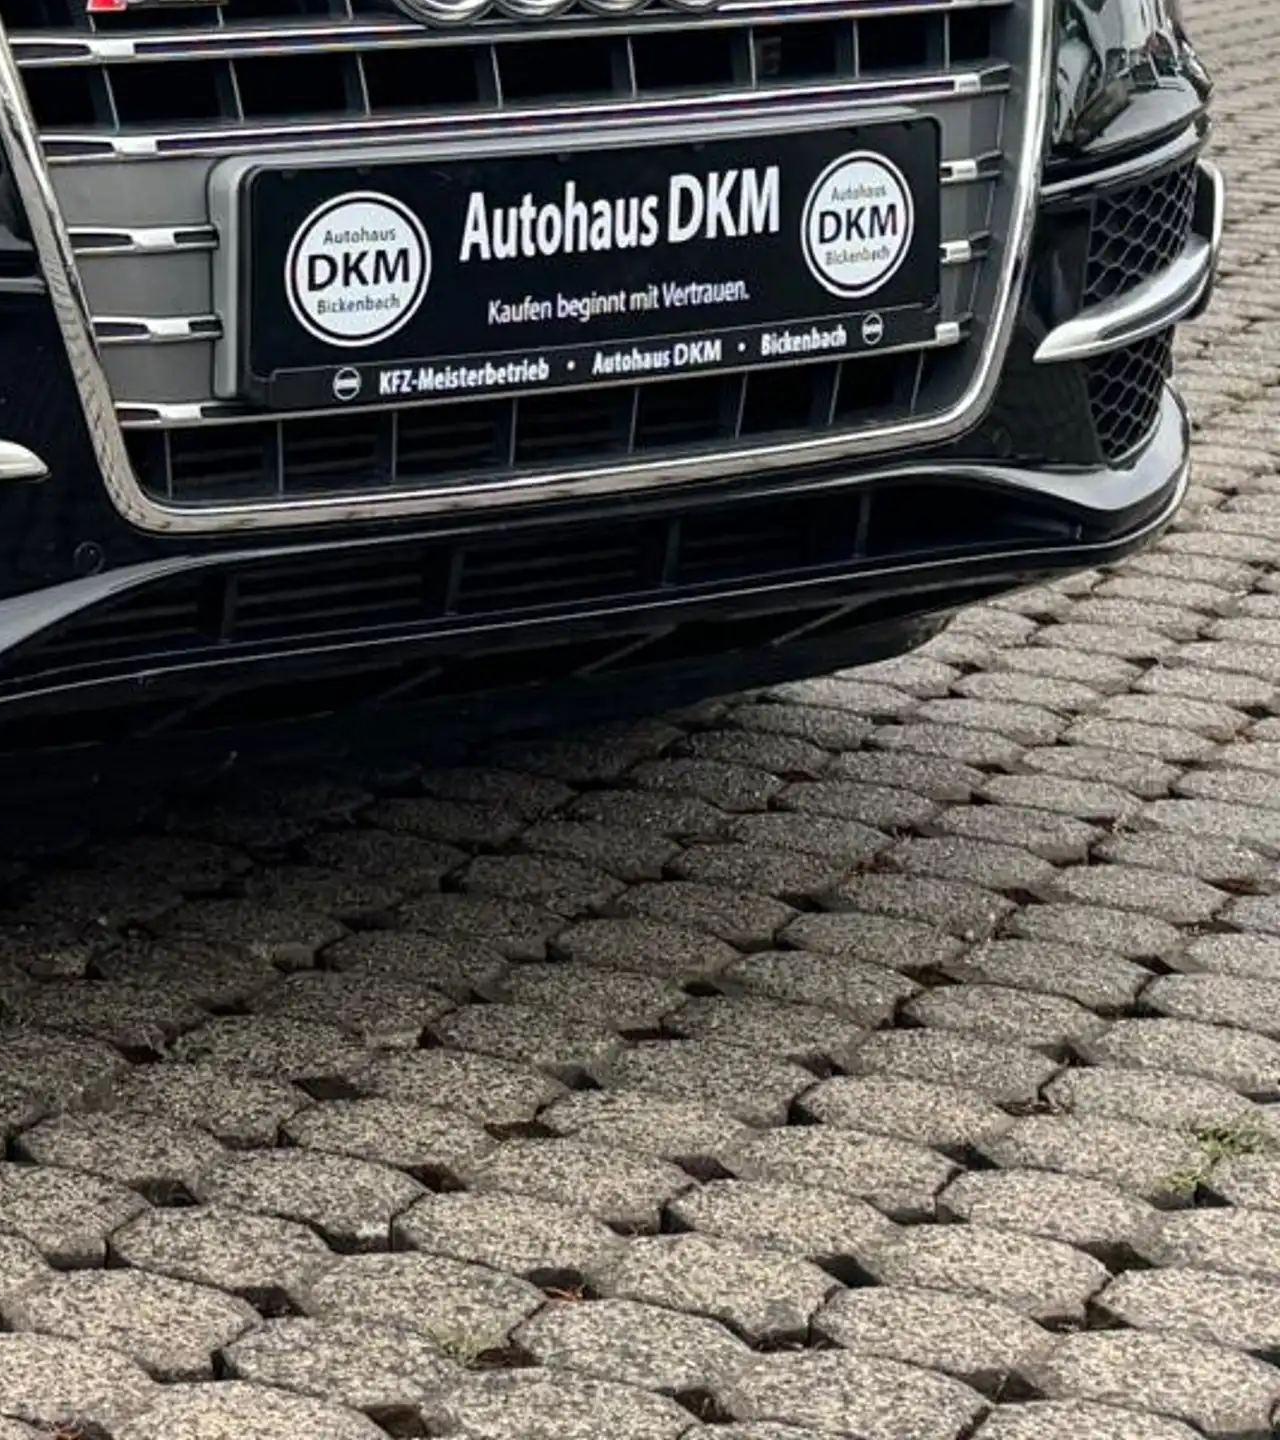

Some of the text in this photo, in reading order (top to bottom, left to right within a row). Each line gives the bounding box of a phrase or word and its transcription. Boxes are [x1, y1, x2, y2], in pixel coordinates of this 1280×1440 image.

[459, 165, 781, 261] Autohaus DKM
[831, 184, 887, 201] Autohaus
[323, 227, 396, 245] Autohaus
[818, 203, 898, 245] DKM
[307, 248, 411, 292] DKM
[825, 246, 890, 266] Bickenbach
[316, 293, 401, 315] Bickenbach
[488, 280, 750, 325] Kaufen beginnt mit Vertrauen.
[379, 357, 550, 396] KFZ-Meisterbetrieb
[592, 347, 671, 376] Autohaus
[674, 339, 723, 366] DKM
[761, 324, 848, 356] Bickenbach
